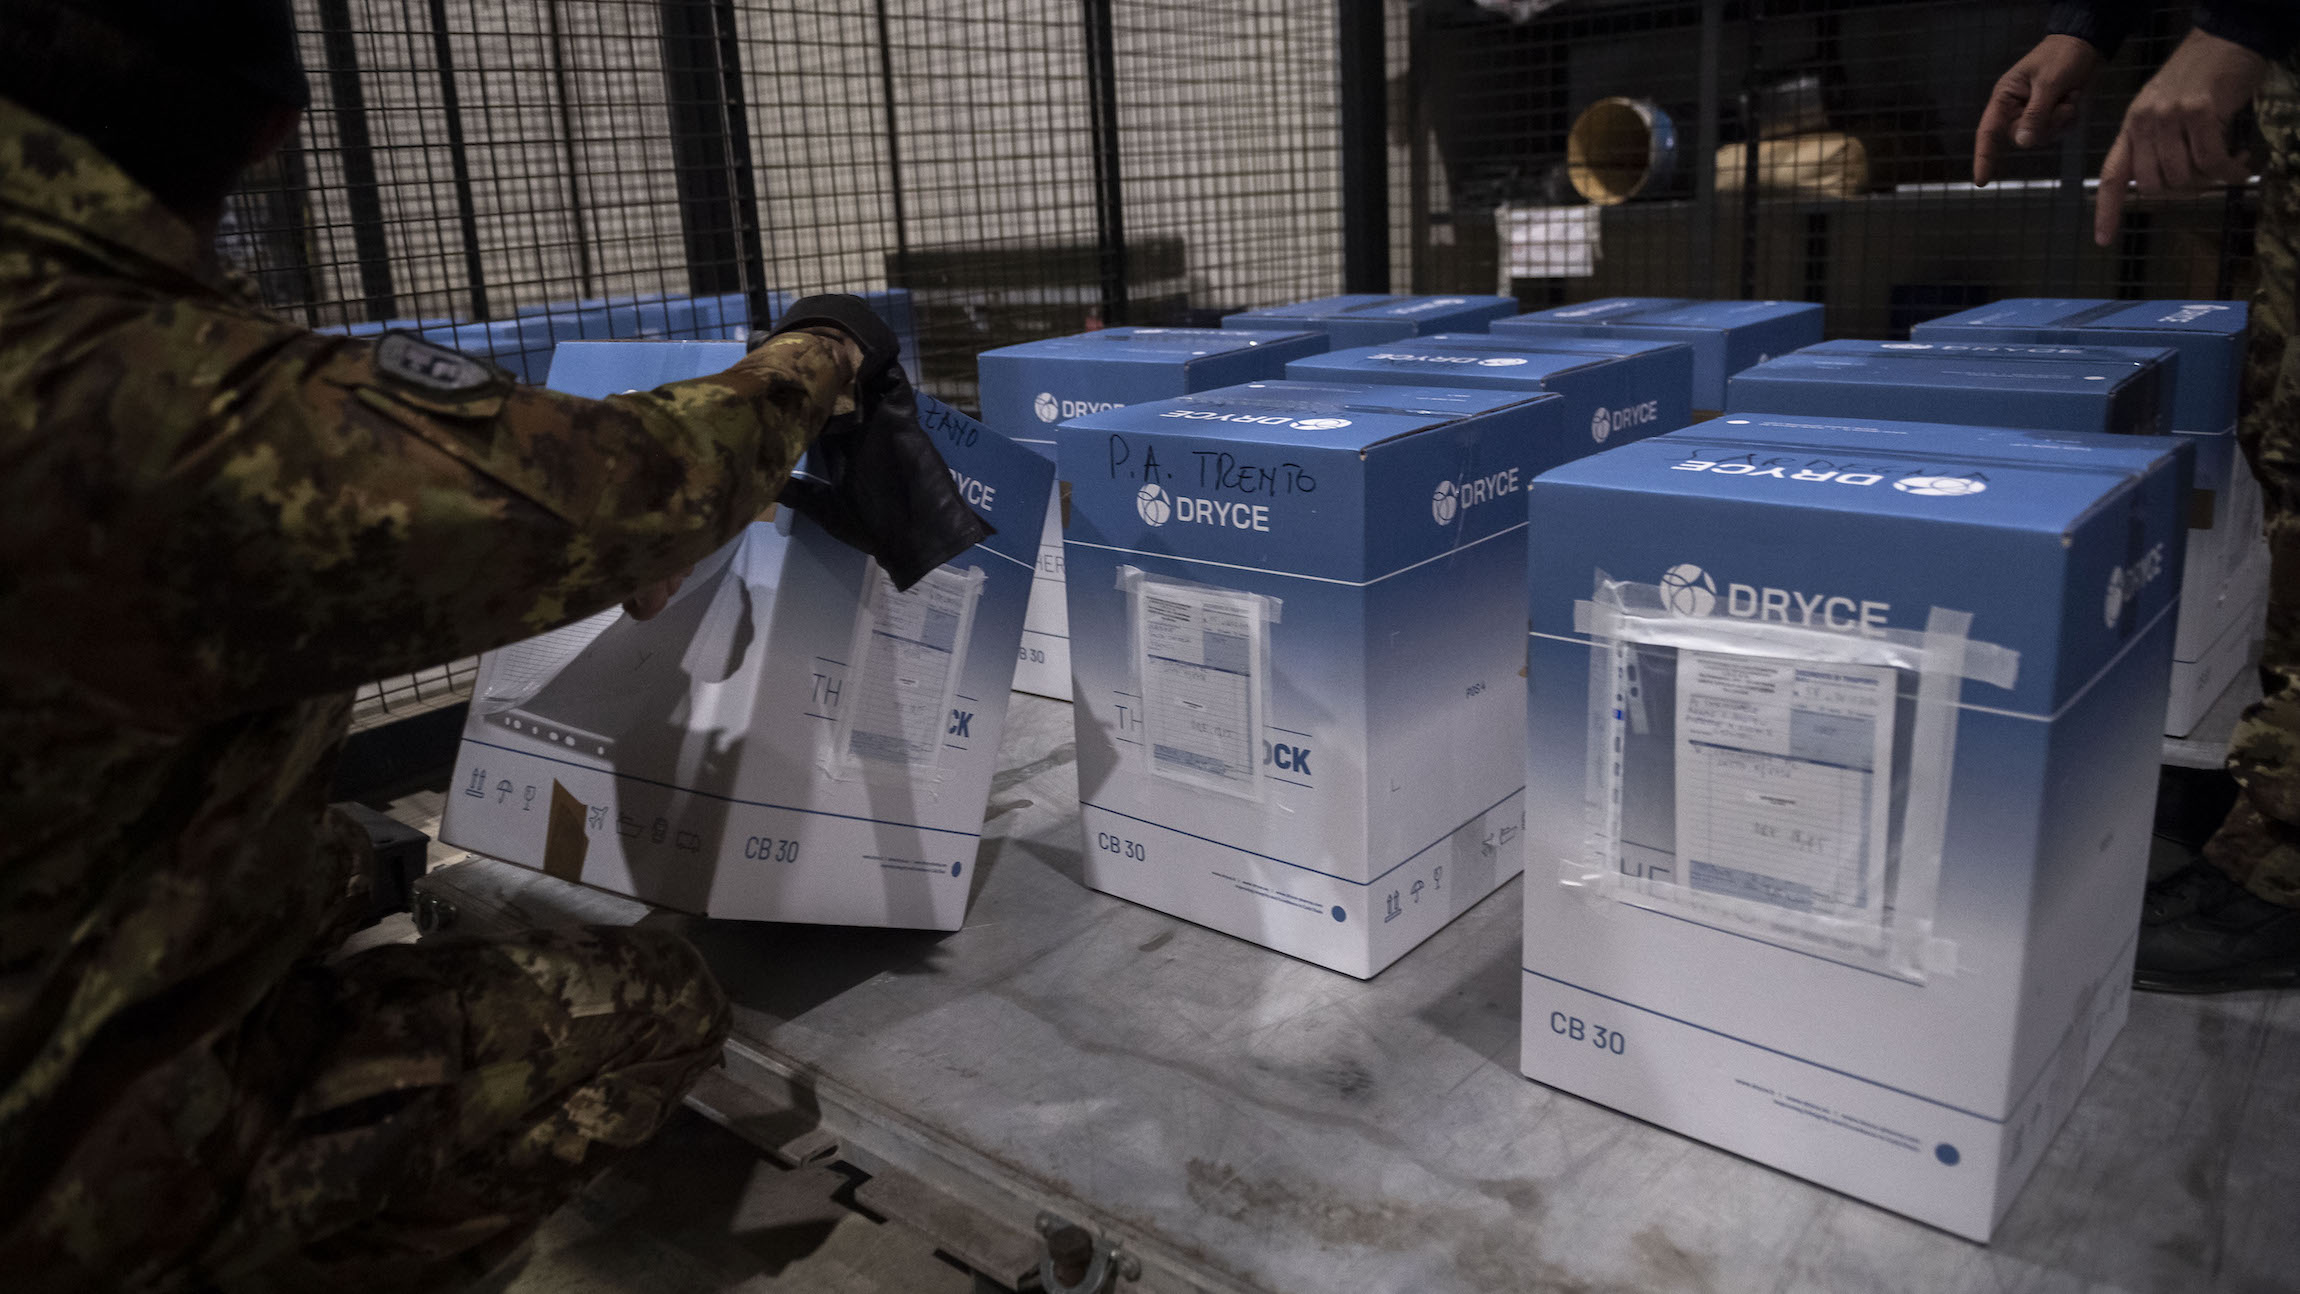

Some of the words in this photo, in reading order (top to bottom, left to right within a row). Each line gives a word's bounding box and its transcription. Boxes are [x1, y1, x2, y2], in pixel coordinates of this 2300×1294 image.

[1159, 410, 1294, 425] DRYCE
[1612, 400, 1658, 431] DRYCE
[1109, 434, 1173, 484] P.A.
[1191, 451, 1317, 497] TRENTO
[1670, 460, 1885, 486] DRYCE
[948, 468, 997, 512] YCE
[1460, 466, 1520, 509] DRYCE
[1176, 496, 1271, 532] DRYCE
[1727, 583, 1891, 637] DRYCE
[1029, 648, 1046, 664] 30
[811, 672, 843, 707] TH
[744, 836, 773, 861] CB
[775, 839, 800, 864] 30
[1098, 832, 1121, 854] CB
[1125, 839, 1146, 862] 30
[1550, 1011, 1585, 1041] CB
[1592, 1024, 1626, 1056] 30
